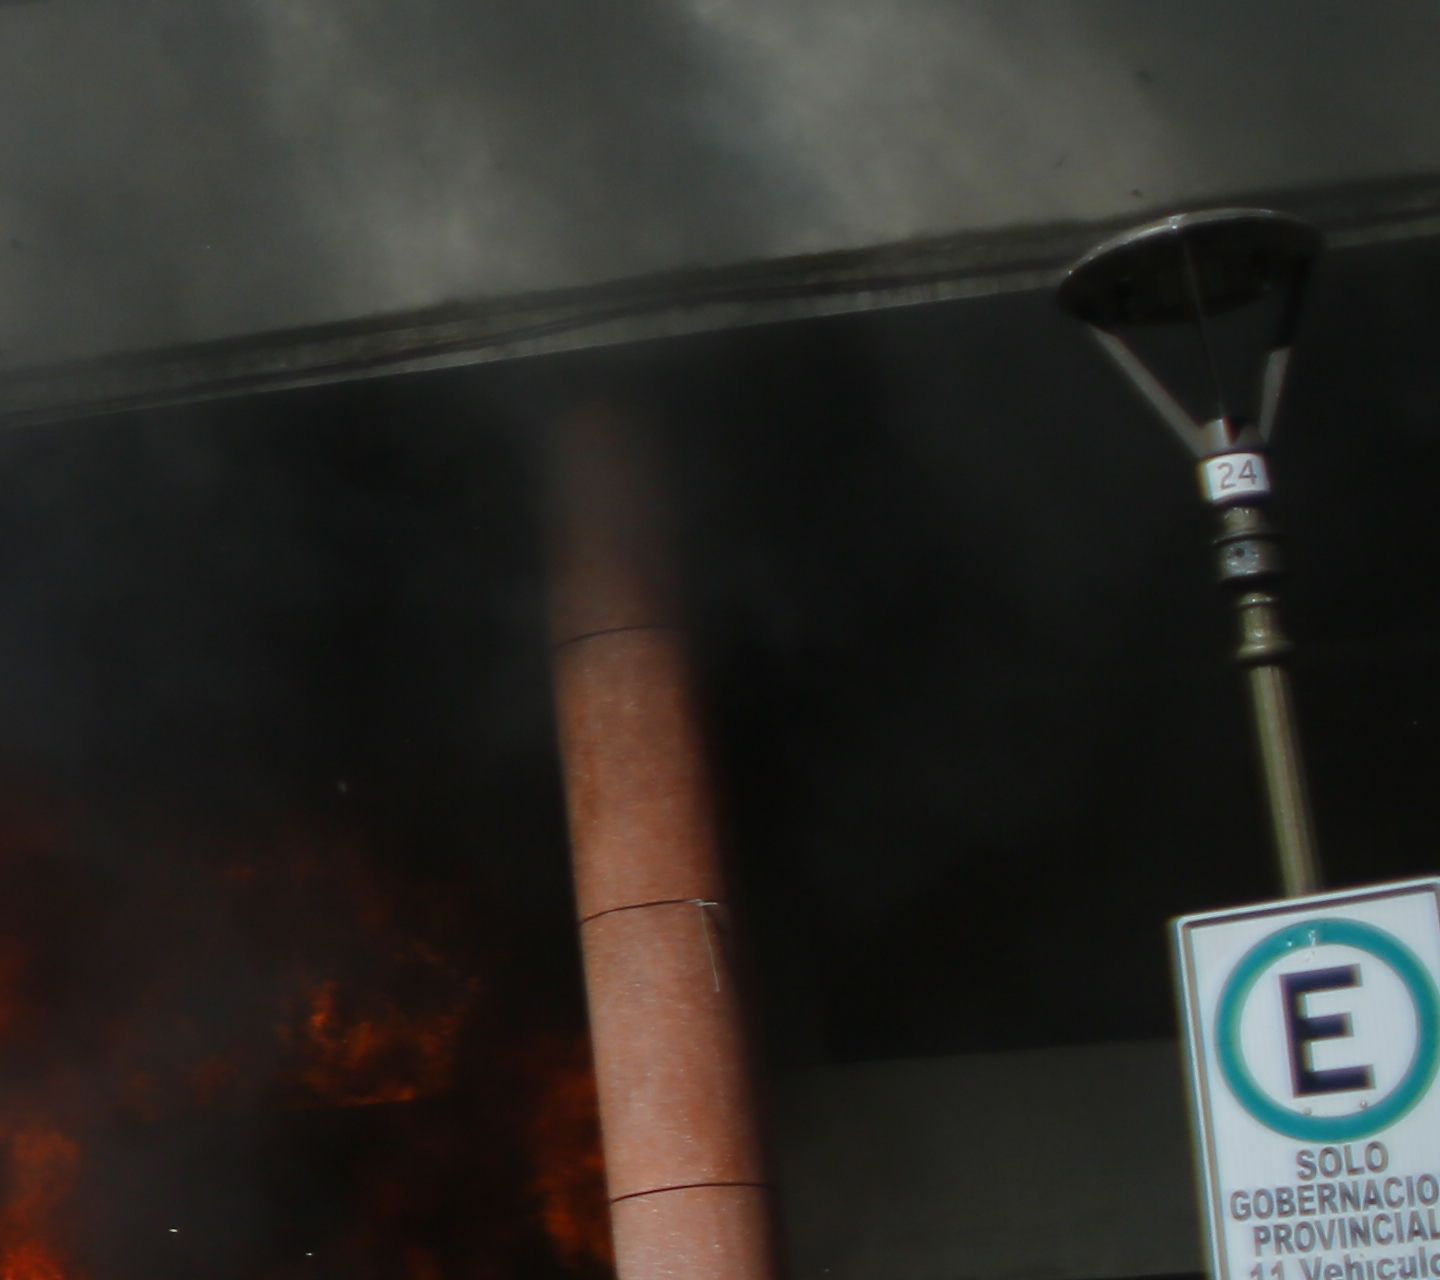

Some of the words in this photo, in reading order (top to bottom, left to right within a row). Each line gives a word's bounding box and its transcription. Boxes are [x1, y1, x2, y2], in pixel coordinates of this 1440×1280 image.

[1280, 963, 1375, 1099] E
[1296, 1140, 1390, 1182] SOLO
[1230, 1173, 1440, 1222] GOBERNACIO
[1253, 1208, 1440, 1258] PROVINCIAL
